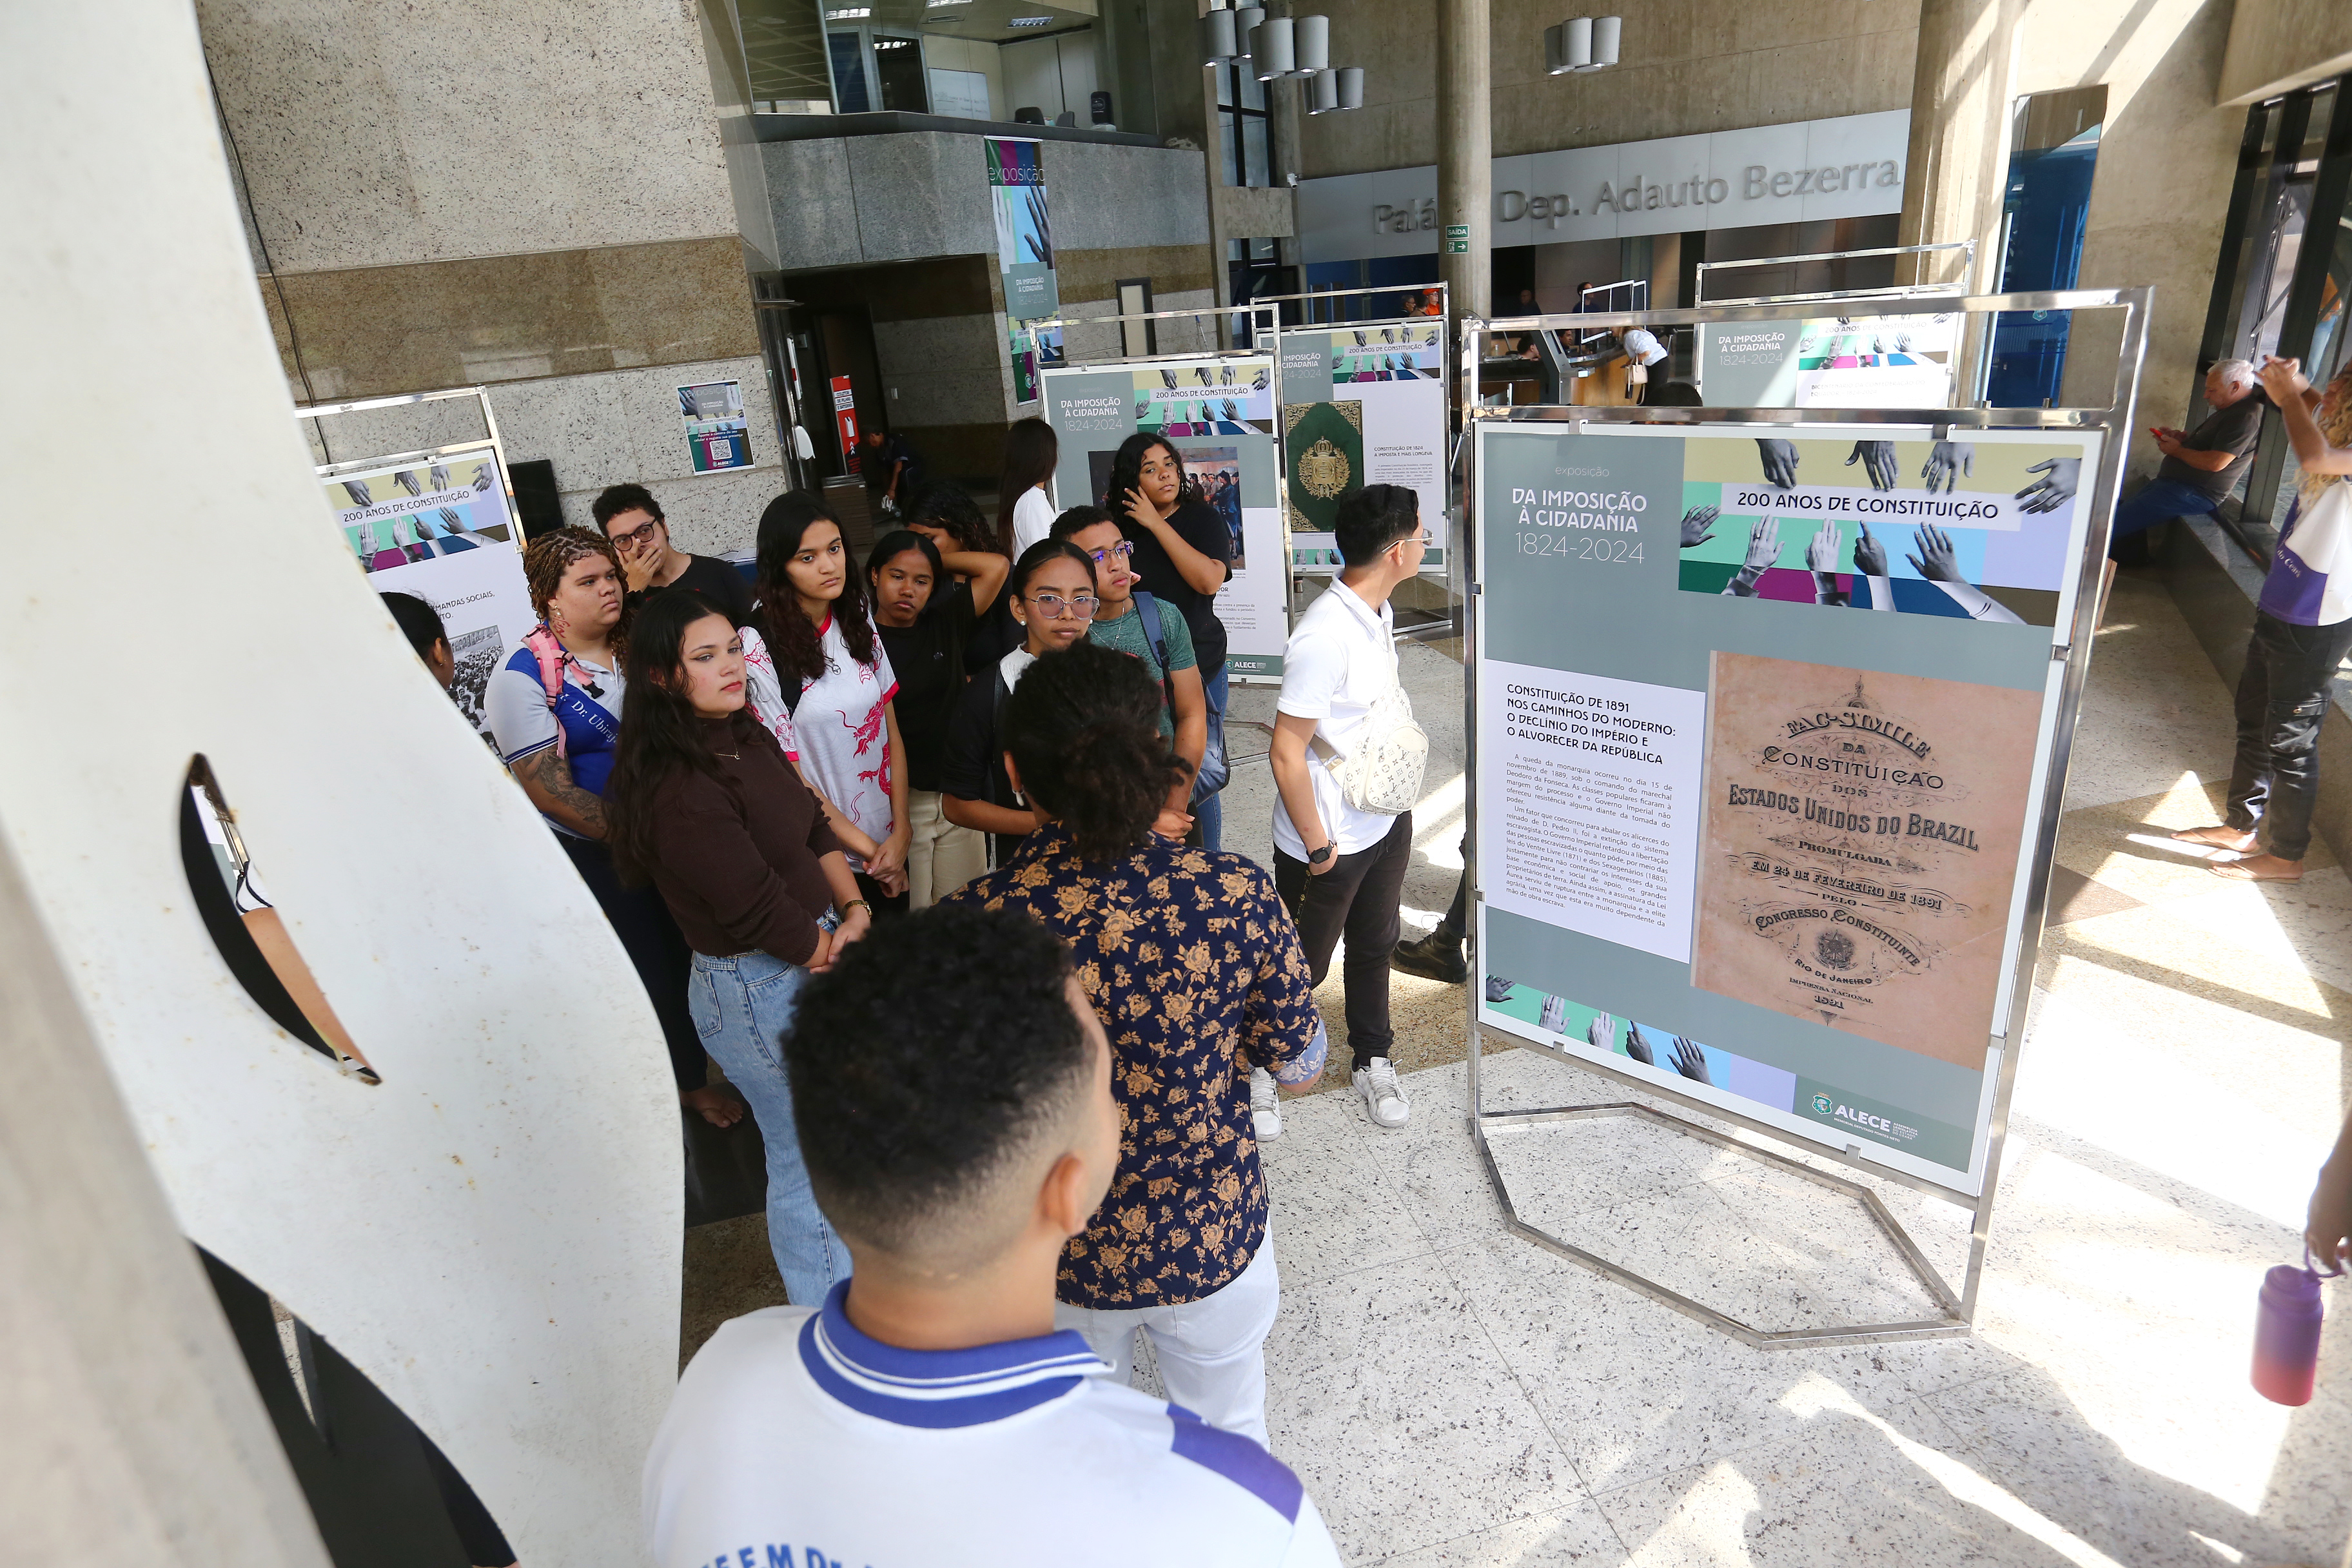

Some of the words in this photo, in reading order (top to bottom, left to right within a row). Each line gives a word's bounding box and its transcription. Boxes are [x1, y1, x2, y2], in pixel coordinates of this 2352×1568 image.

[988, 164, 1045, 184] exposição
[1499, 190, 1581, 230] Dep.
[1594, 175, 1730, 216] Adauto
[1743, 159, 1901, 201] Bezerra
[1718, 336, 1731, 345] DA
[1734, 332, 1785, 344] IMPOSIÇÃO
[1874, 322, 1927, 331] CONSTITUIÇÃO
[1283, 353, 1320, 362] IMPOSIÇÃO
[1720, 354, 1783, 366] 1824-2024
[1721, 343, 1728, 353] À
[1730, 342, 1780, 352] CIDADANIA
[1061, 399, 1073, 408] DA
[1075, 397, 1121, 408] IMPOSIÇÃO
[1200, 387, 1248, 397] CONSTITUIÇÃO
[1064, 418, 1122, 431] 1824-2024
[1065, 407, 1071, 417] À
[1073, 407, 1119, 417] CIDADANIA
[1555, 466, 1610, 477] exposição
[344, 511, 362, 522] 200
[366, 505, 391, 518] ANOS
[393, 503, 406, 513] DE
[407, 490, 470, 509] CONSTITUIÇÃO
[1512, 487, 1536, 505] DA
[1542, 489, 1647, 514] IMPOSIÇÃO
[1738, 492, 1770, 507] 200
[1775, 494, 1822, 511] ANOS
[1828, 497, 1850, 511] DE
[1856, 498, 1999, 521] CONSTITUIÇÃO
[1518, 505, 1530, 524] À
[1536, 509, 1638, 533] CIDADANIA
[1515, 532, 1645, 564] 1824-2024
[466, 591, 495, 603] SOCIAIS,
[571, 700, 588, 718] Dr.
[1507, 683, 1585, 705] CONSTITUIÇÃO
[1588, 697, 1603, 709] DE
[1606, 700, 1629, 713] 1891
[1507, 698, 1528, 710] NOS
[1531, 702, 1589, 721] CAMINHOS
[1592, 712, 1609, 724] DO
[1612, 716, 1676, 736] MODERNO:
[1507, 712, 1515, 722] O
[1518, 714, 1568, 732] DECLÍNIO
[1571, 723, 1588, 736] DO
[1592, 727, 1638, 745] IMPÉRIO
[1642, 736, 1648, 747] E
[1507, 727, 1515, 736] O
[1518, 729, 1579, 749] ALVORECER
[1582, 740, 1598, 752] DA
[1602, 744, 1663, 765] REPÚBLICA
[1788, 712, 1932, 760] FAC-SIMILE
[1843, 742, 1867, 754] DA
[1506, 761, 1537, 772] novembro
[1551, 770, 1568, 779] 1889,
[1594, 780, 1625, 791] comando
[1641, 790, 1672, 801] marechal
[1522, 756, 1542, 765] queda
[1556, 763, 1591, 774] monarquia
[1594, 771, 1619, 780] ocorreu
[1663, 783, 1673, 792] de
[1761, 745, 1944, 790] CONSTITUIÇÃO
[1506, 769, 1533, 780] Deodoro
[1544, 777, 1570, 789] Fonseca.
[1582, 785, 1603, 796] classes
[1605, 792, 1638, 803] populares
[1640, 798, 1665, 808] ficaram
[1832, 784, 1868, 798] DOS
[1728, 784, 1801, 814] ESTADOS
[1805, 797, 1871, 833] UNIDOS
[1876, 816, 1901, 835] DO
[1906, 812, 1980, 852] BRAZIL
[1798, 840, 1892, 867] PROMULGADA
[1751, 861, 1769, 872] EM
[1773, 865, 1790, 876] 24
[1792, 869, 1810, 881] DE
[1812, 874, 1885, 897] FEVEREIRO
[1887, 890, 1906, 902] DE
[1910, 894, 1943, 910] 1891
[1822, 893, 1857, 906] PELO
[1756, 908, 1828, 931] CONGRESSO
[1830, 909, 1921, 967] CONSTITUINTE
[1794, 958, 1812, 972] RIO
[1815, 970, 1827, 979] DE
[1829, 975, 1872, 985] JANEIRO
[1790, 977, 1829, 992] IMPRENSA
[1831, 988, 1874, 1004] NACIONAL
[1834, 1117, 1854, 1127] MEMORIAL
[1854, 1123, 1874, 1134] DEPUTADO
[1874, 1130, 1889, 1139] PONTES
[1835, 1104, 1891, 1133] ALECE
[1892, 1125, 1918, 1136] LEGISLATIVA
[1893, 1122, 1918, 1133] ASSEMBLEIA
